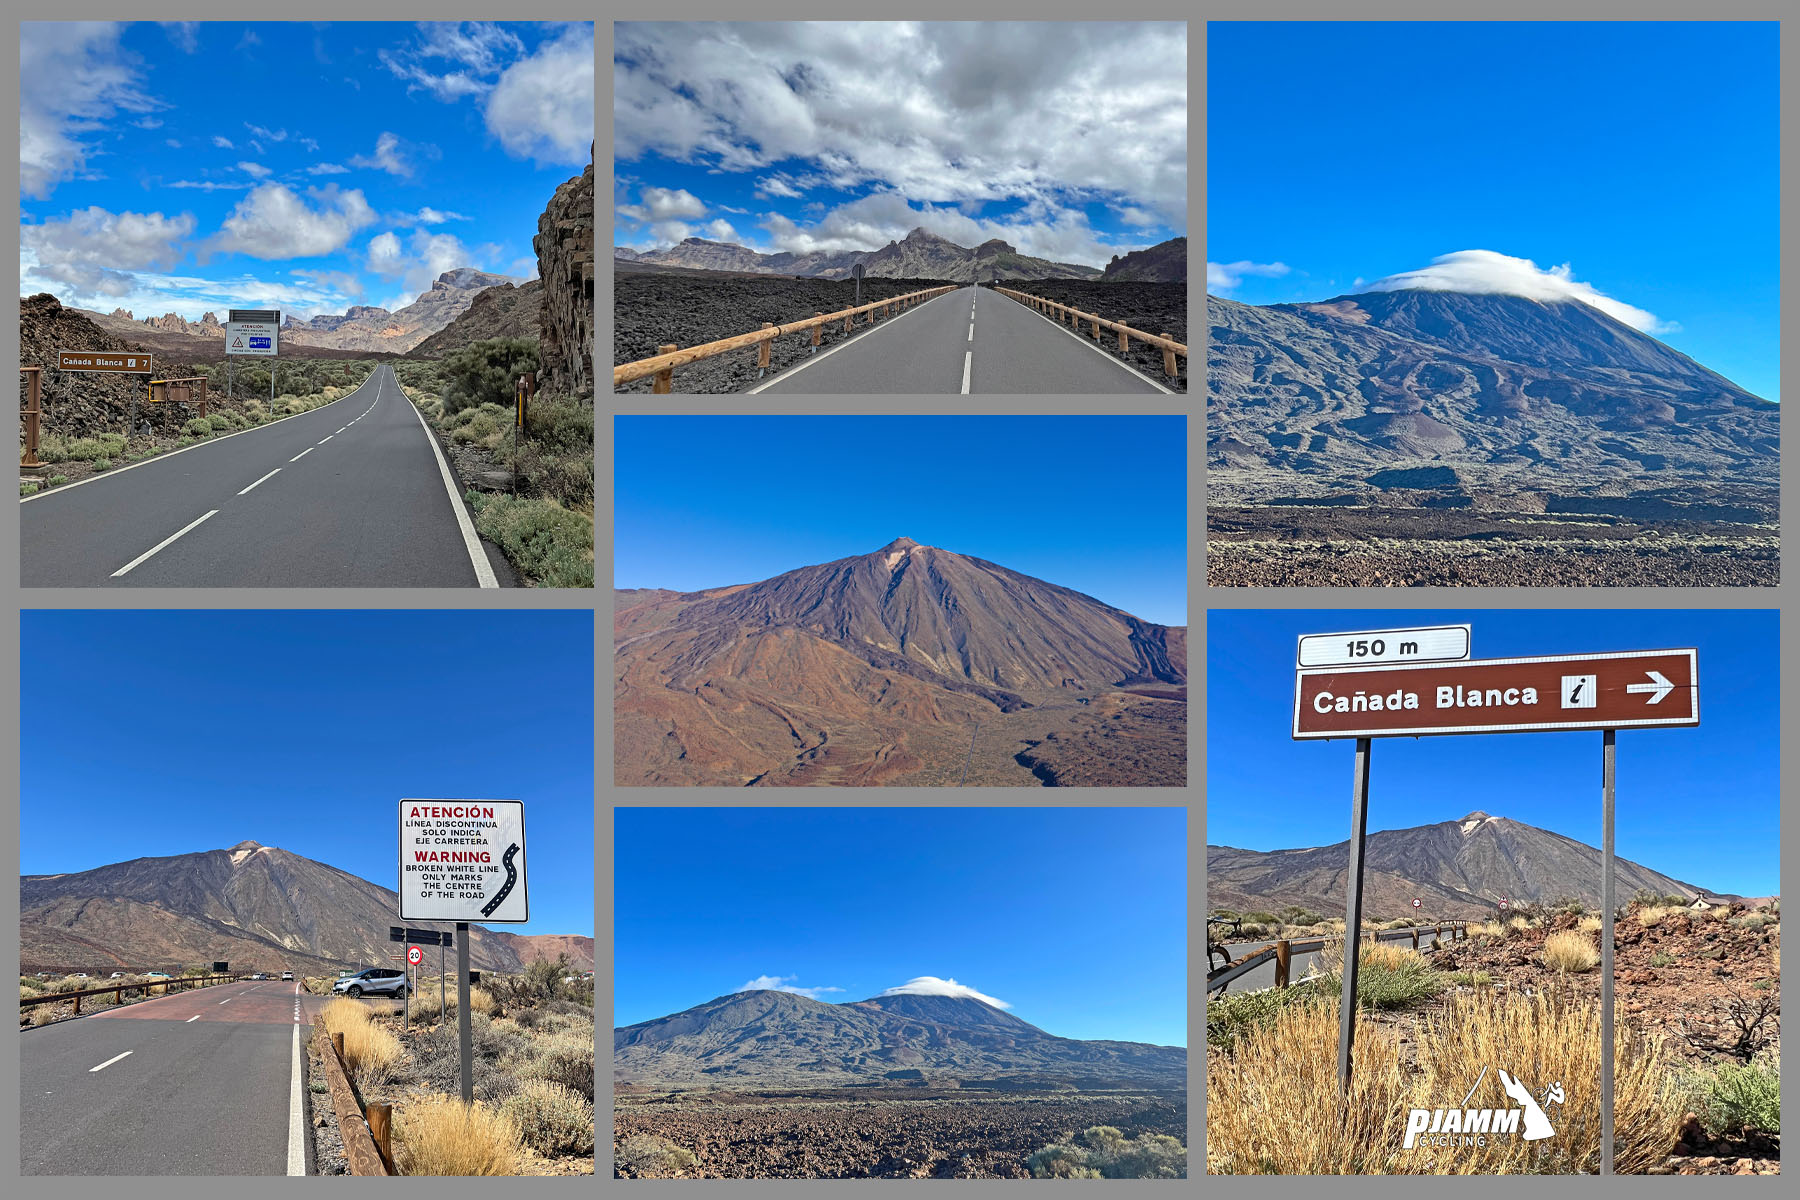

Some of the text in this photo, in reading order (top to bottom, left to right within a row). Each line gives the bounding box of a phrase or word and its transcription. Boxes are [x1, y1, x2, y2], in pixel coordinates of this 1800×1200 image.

[96, 358, 123, 366] Blanca
[1346, 639, 1419, 658] 150 m
[1313, 690, 1420, 714] Cañada
[1436, 685, 1539, 710] Blanca
[410, 805, 494, 819] ATENCIÓN
[405, 819, 498, 828] LÍNEA DISCONTINUA
[450, 829, 482, 837] INDICA
[414, 851, 491, 863] WARNING
[446, 865, 475, 873] WHITE
